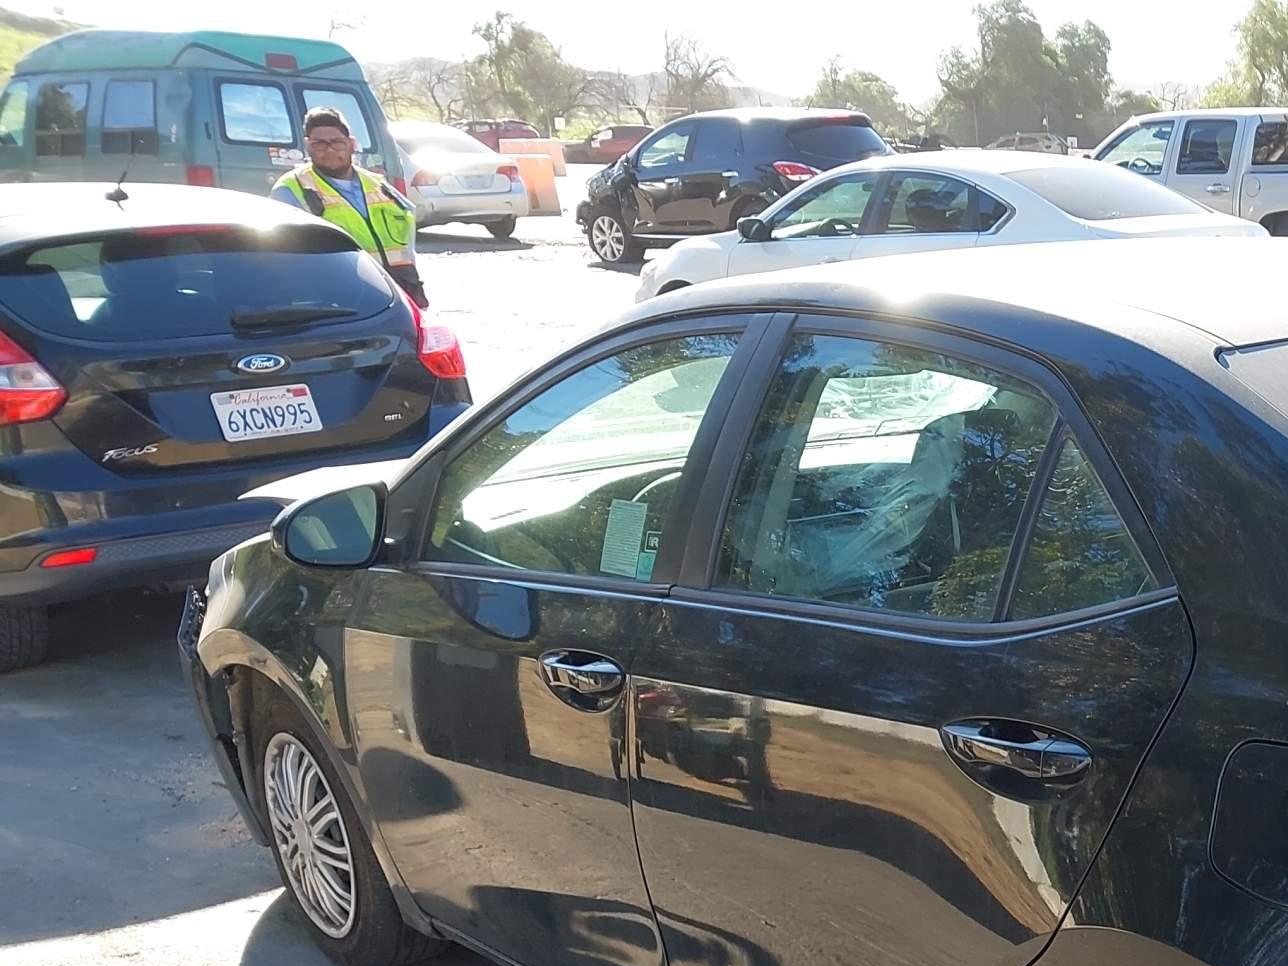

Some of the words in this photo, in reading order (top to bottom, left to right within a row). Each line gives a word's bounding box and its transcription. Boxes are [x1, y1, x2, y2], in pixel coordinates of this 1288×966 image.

[249, 358, 275, 370] Ford
[233, 391, 287, 406] California
[227, 402, 313, 433] 6XCN995
